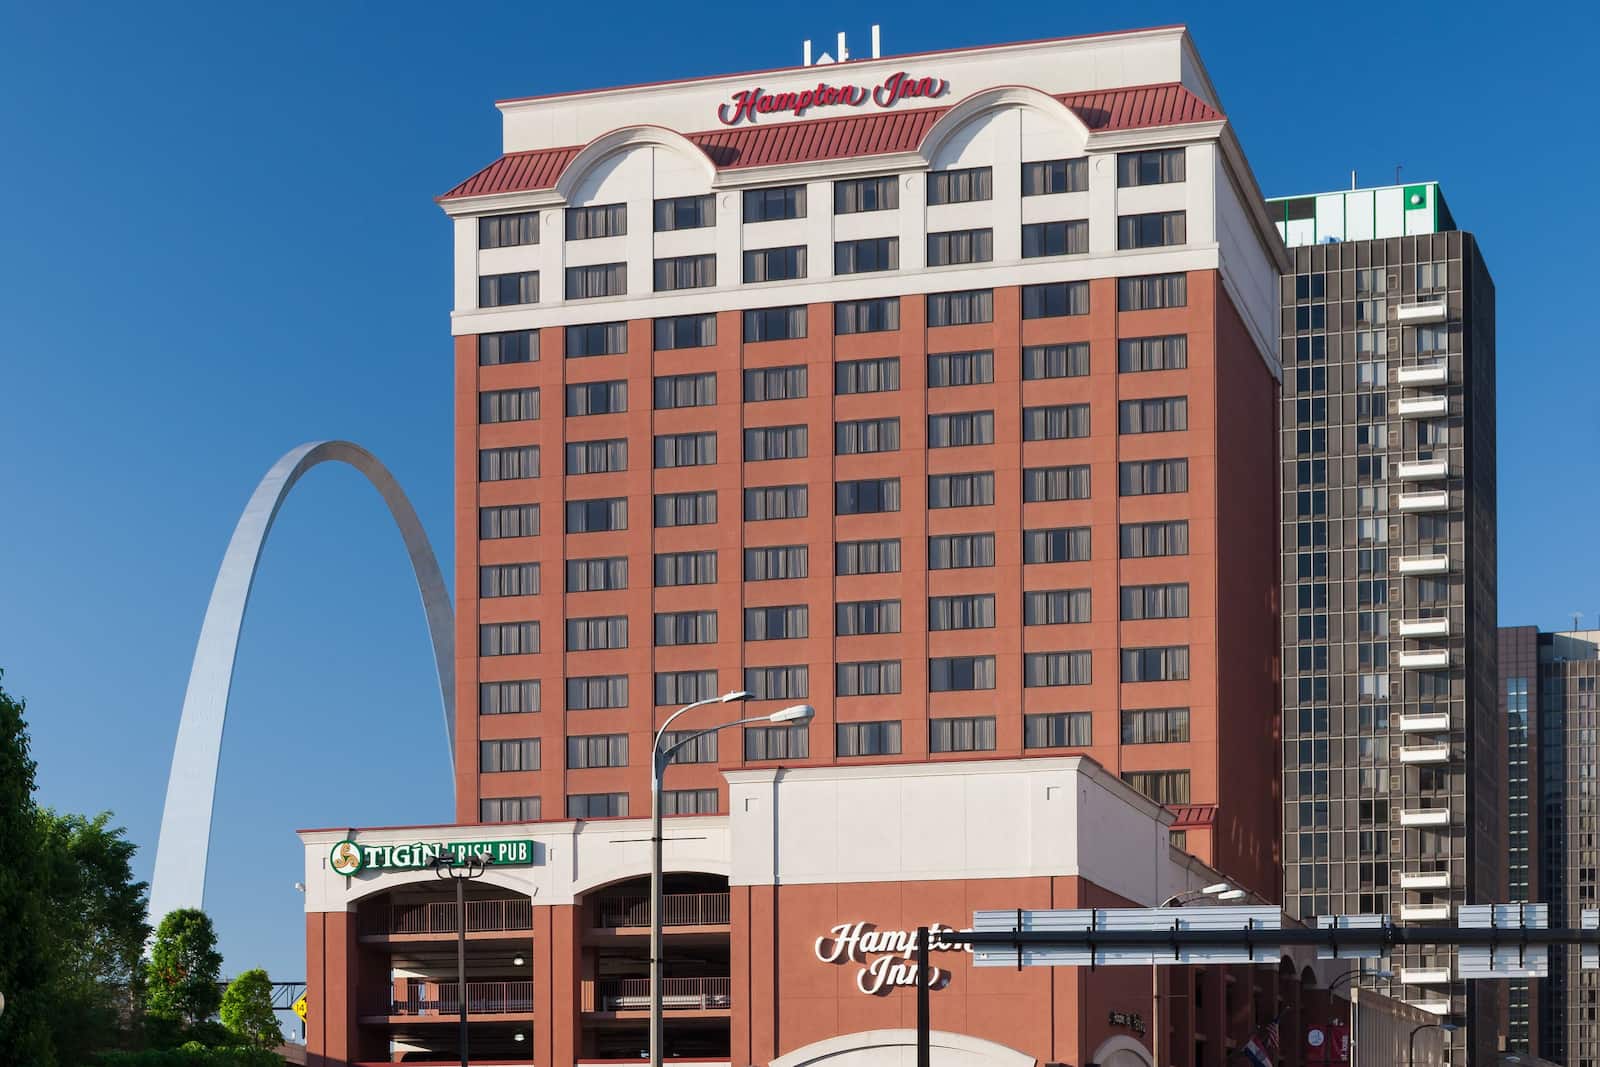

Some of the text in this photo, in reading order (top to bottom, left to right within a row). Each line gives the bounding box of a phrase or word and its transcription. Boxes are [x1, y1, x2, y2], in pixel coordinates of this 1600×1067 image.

[718, 71, 945, 126] Hampton Inn
[499, 843, 527, 861] PUB
